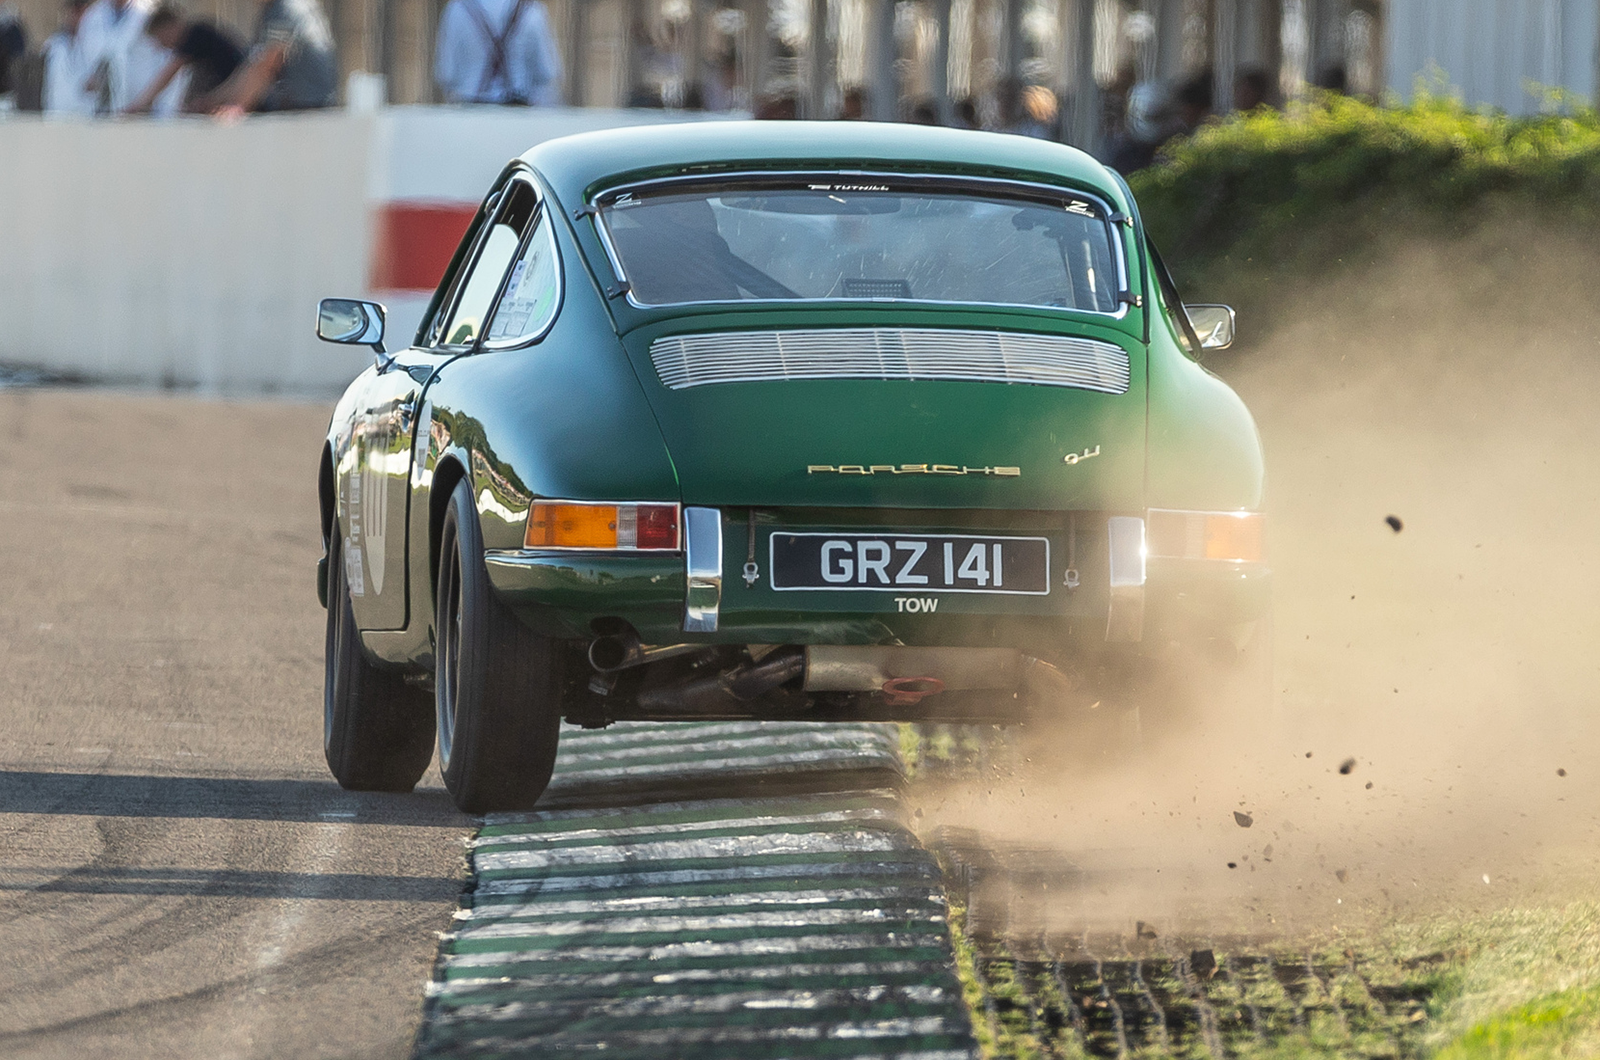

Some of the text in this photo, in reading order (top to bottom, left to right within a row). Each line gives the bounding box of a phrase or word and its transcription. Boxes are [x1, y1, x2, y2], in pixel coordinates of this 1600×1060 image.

[807, 464, 1020, 477] PORSCHE
[820, 540, 1002, 587] GRZ 141
[894, 598, 938, 613] TOW
